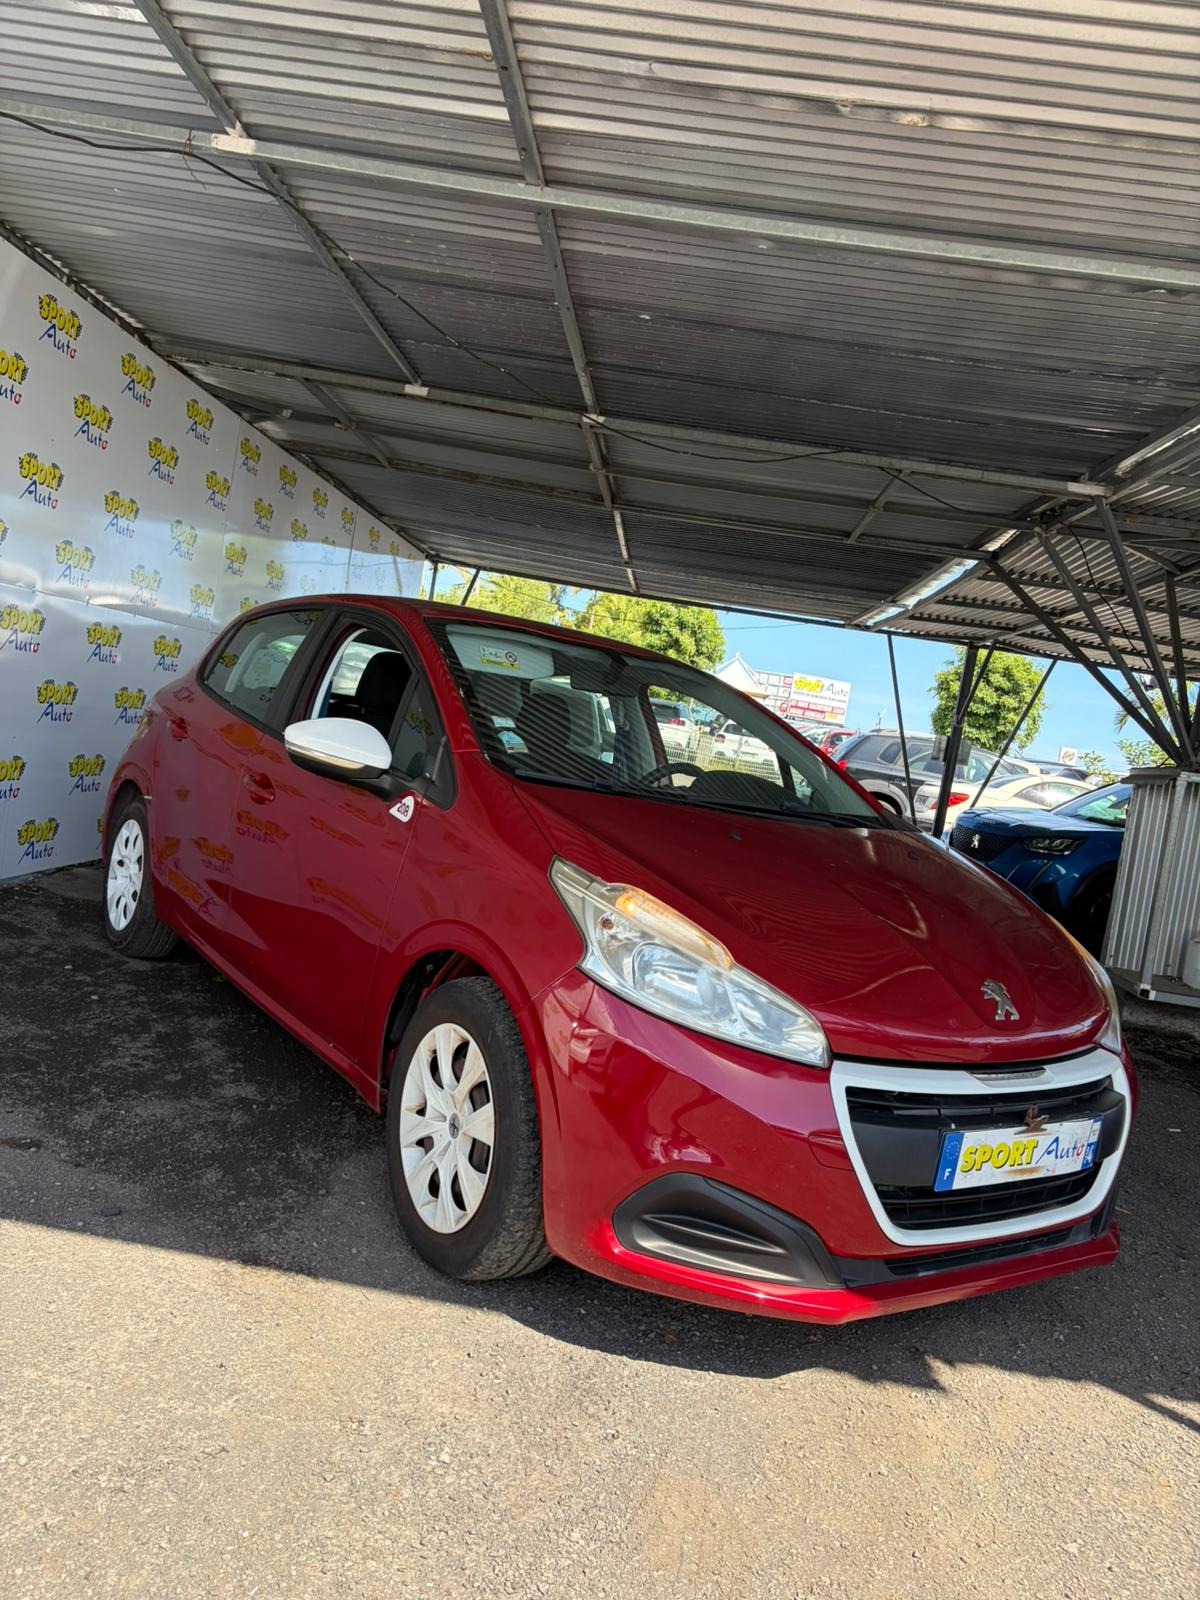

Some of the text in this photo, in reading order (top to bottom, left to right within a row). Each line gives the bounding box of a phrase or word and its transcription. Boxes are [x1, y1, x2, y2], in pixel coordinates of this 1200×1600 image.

[40, 296, 81, 340] SPORT
[39, 324, 76, 359] Auto
[0, 350, 26, 384] ORT
[121, 354, 155, 392] SPORT
[0, 383, 22, 404] uto
[121, 378, 151, 407] Auto
[74, 396, 111, 432] SPORT
[186, 400, 213, 430] SPORT
[74, 420, 108, 449] Auto
[186, 420, 210, 445] Auto
[148, 439, 178, 470] SPORT
[19, 454, 62, 491] SPORT
[148, 459, 175, 485] Auto
[19, 479, 58, 509] Auto
[105, 492, 139, 522] SPORT
[104, 514, 134, 538] Auto
[170, 521, 198, 547] SPORT
[56, 542, 95, 572] SPORT
[169, 540, 194, 561] Auto
[56, 564, 90, 589] Auto
[131, 567, 162, 592] SPORT
[130, 586, 158, 607] Auto
[0, 605, 45, 635] SPORT
[1, 629, 40, 653] Auto
[87, 624, 121, 648] SPORT
[154, 637, 181, 658] SPORT
[87, 643, 118, 664] Auto
[153, 654, 178, 672] Auto
[37, 681, 78, 704] SPORT
[115, 689, 146, 709] SPORT
[37, 702, 72, 723] Auto
[115, 707, 143, 725] Auto
[0, 758, 26, 781] ORT
[69, 756, 105, 778] SPORT
[0, 782, 20, 799] uto
[69, 775, 100, 796] Auto
[18, 820, 60, 846] SPORT
[18, 841, 53, 865] Auto
[959, 1138, 1038, 1173] SPORT
[1036, 1136, 1085, 1164] Auto
[944, 1169, 951, 1180] F
